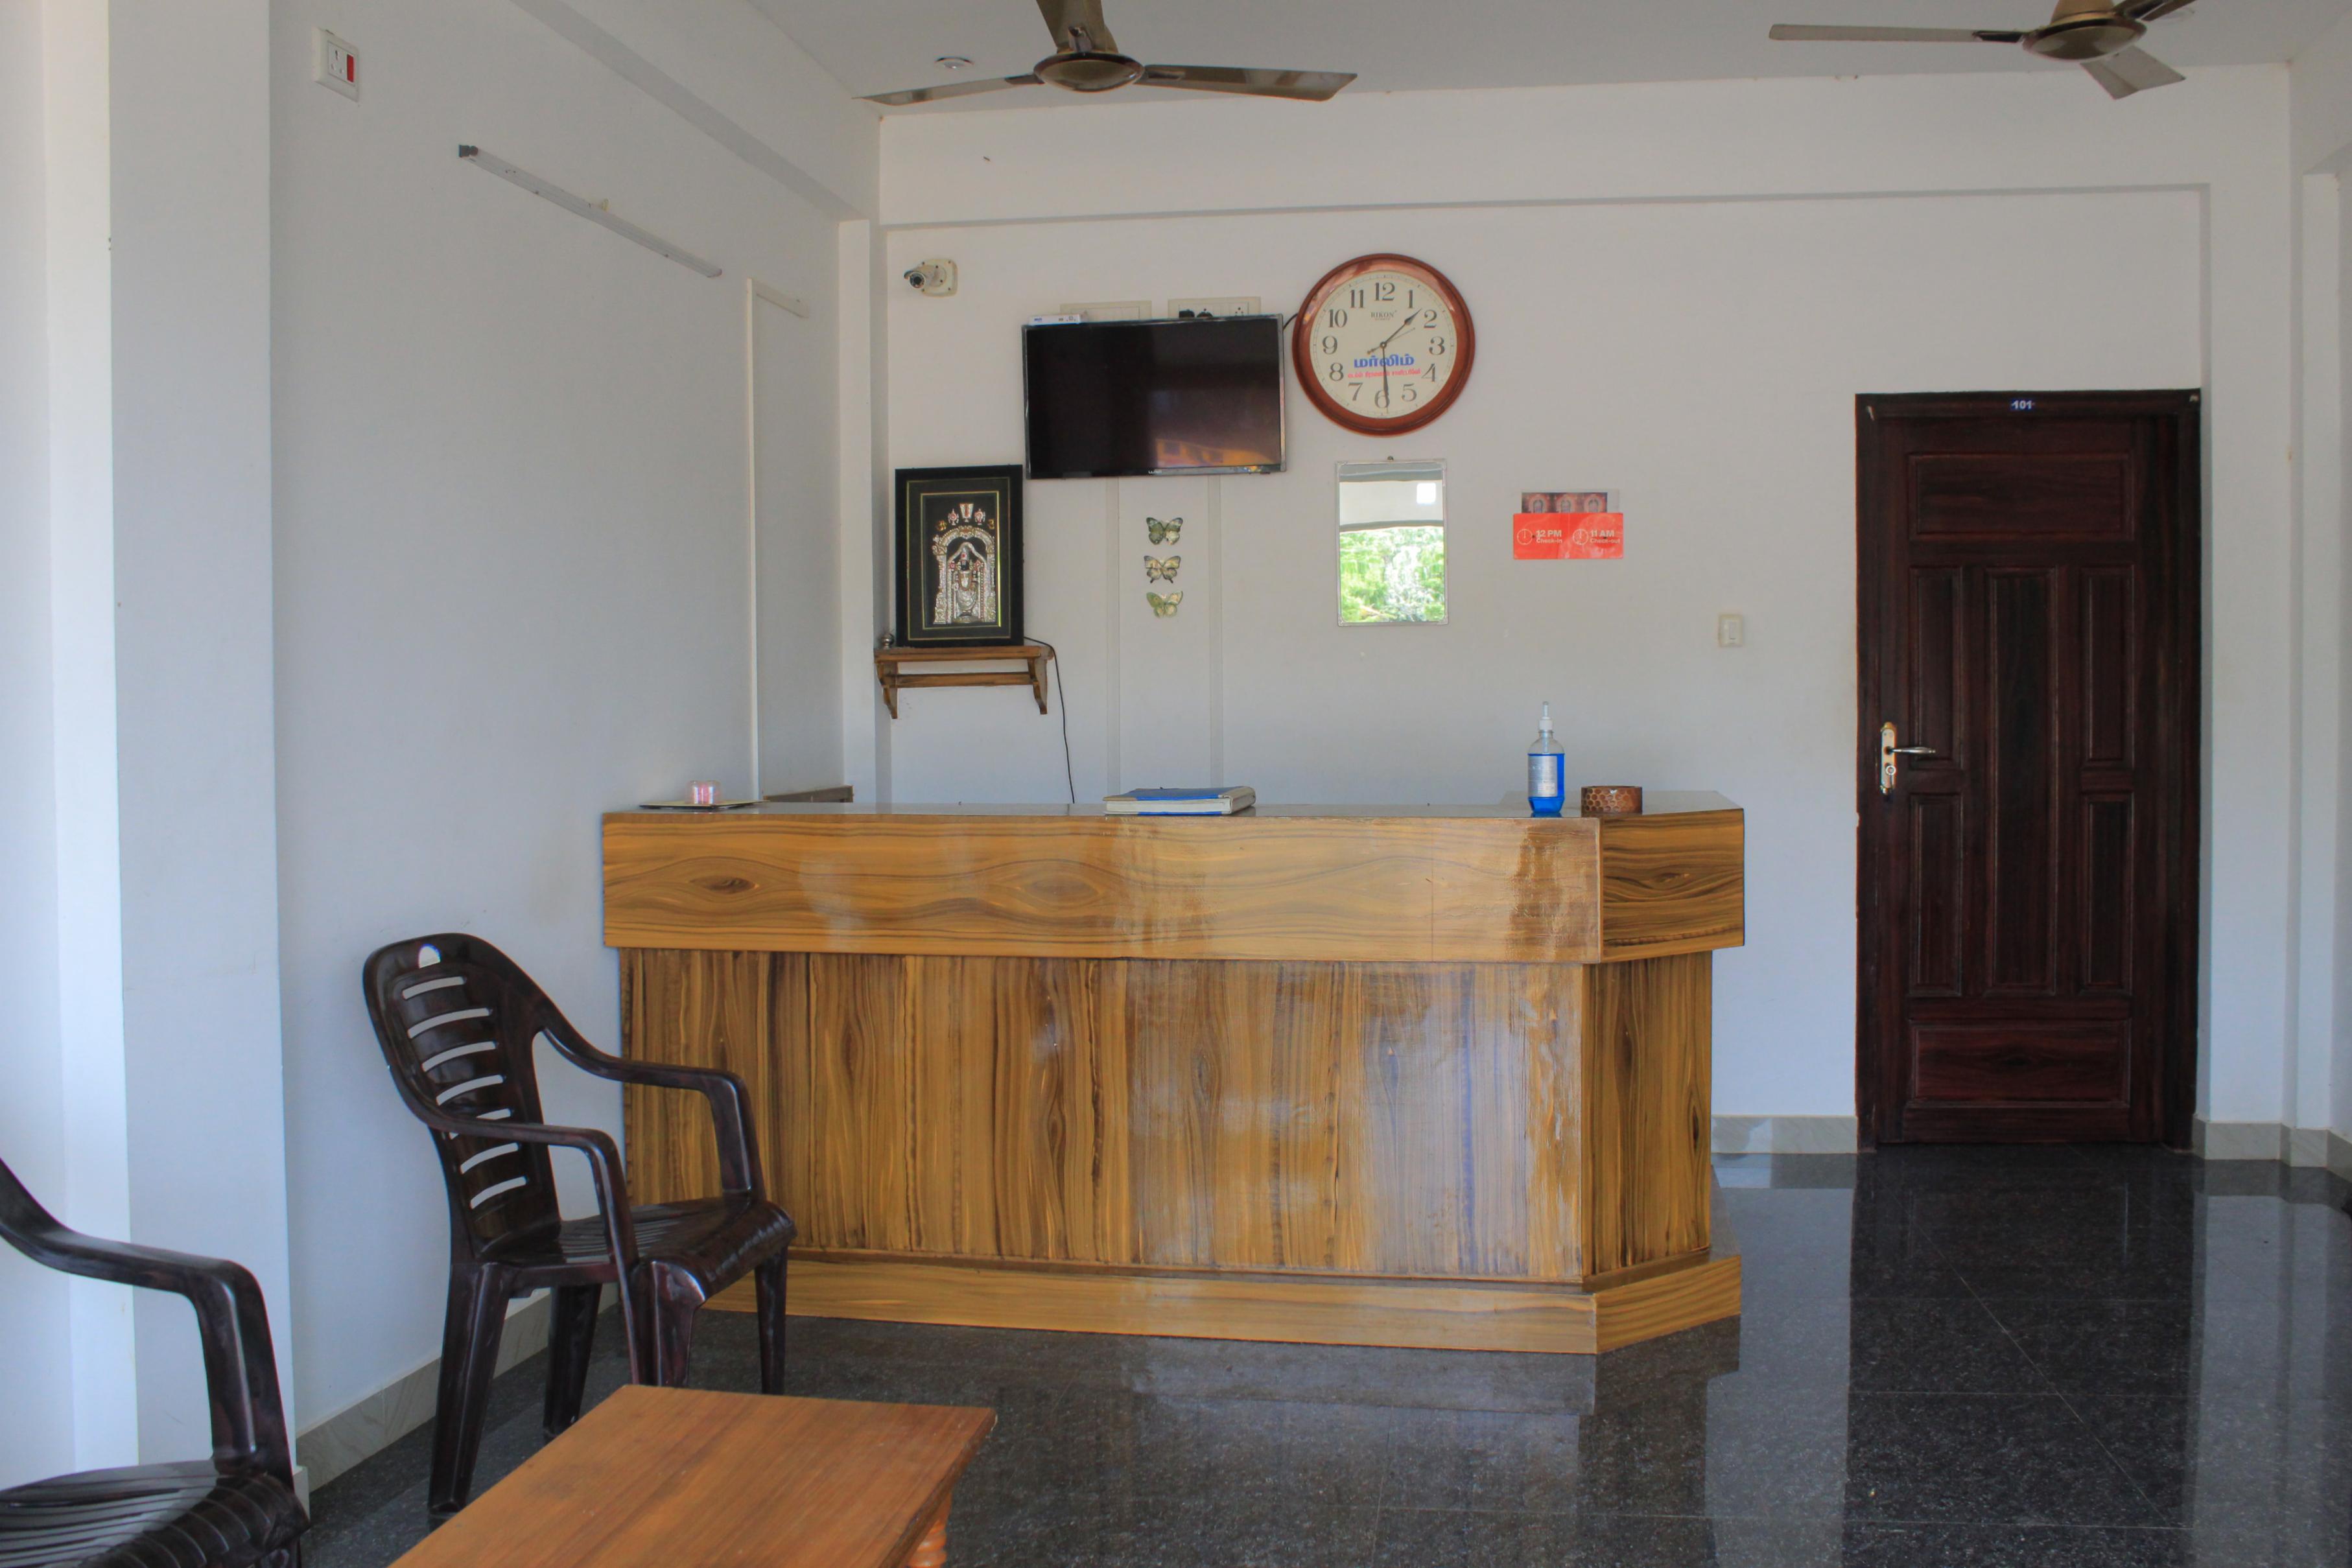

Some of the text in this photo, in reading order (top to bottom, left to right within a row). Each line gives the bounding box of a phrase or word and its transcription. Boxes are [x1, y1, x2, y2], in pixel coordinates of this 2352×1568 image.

[1350, 290, 1364, 309] 11
[1374, 282, 1395, 301] 12
[1408, 290, 1413, 309] 1
[1328, 309, 1347, 328] 10
[1424, 309, 1437, 329] 2
[1323, 336, 1337, 355] 9
[1429, 336, 1445, 355] 3
[1329, 362, 1343, 381] 8
[1421, 363, 1436, 382] 4
[1348, 382, 1363, 401] 7
[1374, 390, 1390, 408] 6
[1401, 384, 1417, 402] 5
[2011, 400, 2032, 410] 101
